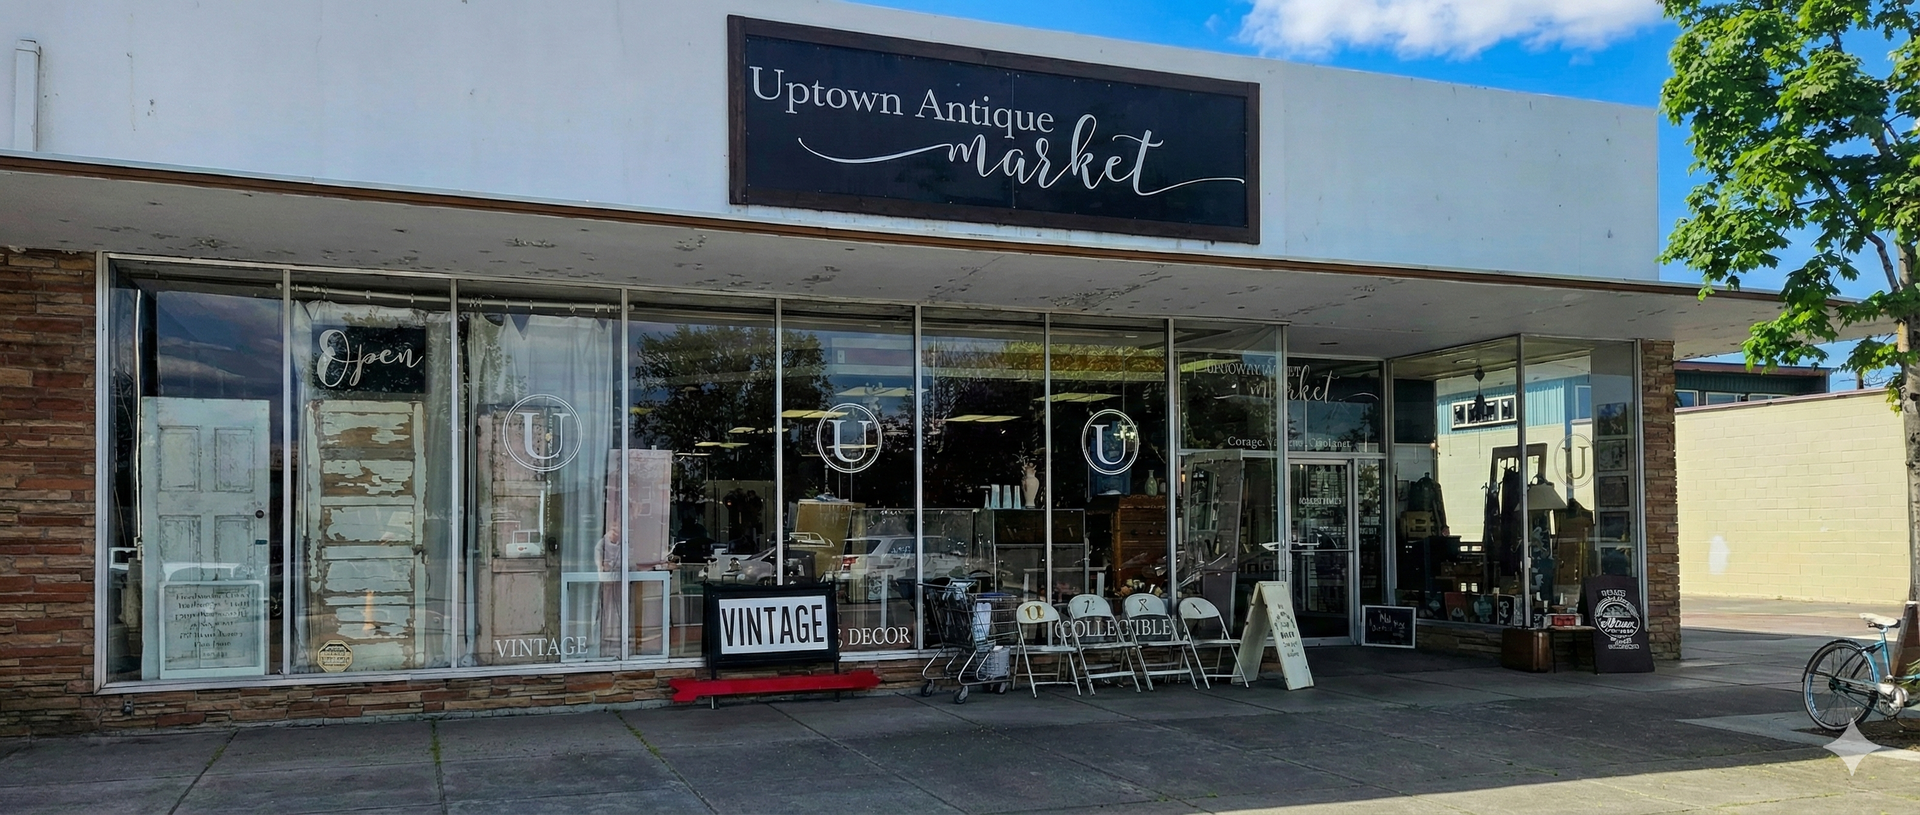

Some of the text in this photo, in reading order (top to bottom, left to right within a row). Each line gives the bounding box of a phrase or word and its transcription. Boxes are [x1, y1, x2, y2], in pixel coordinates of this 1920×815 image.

[749, 66, 1055, 140] Uptown Antique
[317, 328, 424, 389] Open
[494, 635, 589, 659] VINTAGE
[721, 604, 825, 647] VINTAGE
[848, 626, 911, 646] DECOR
